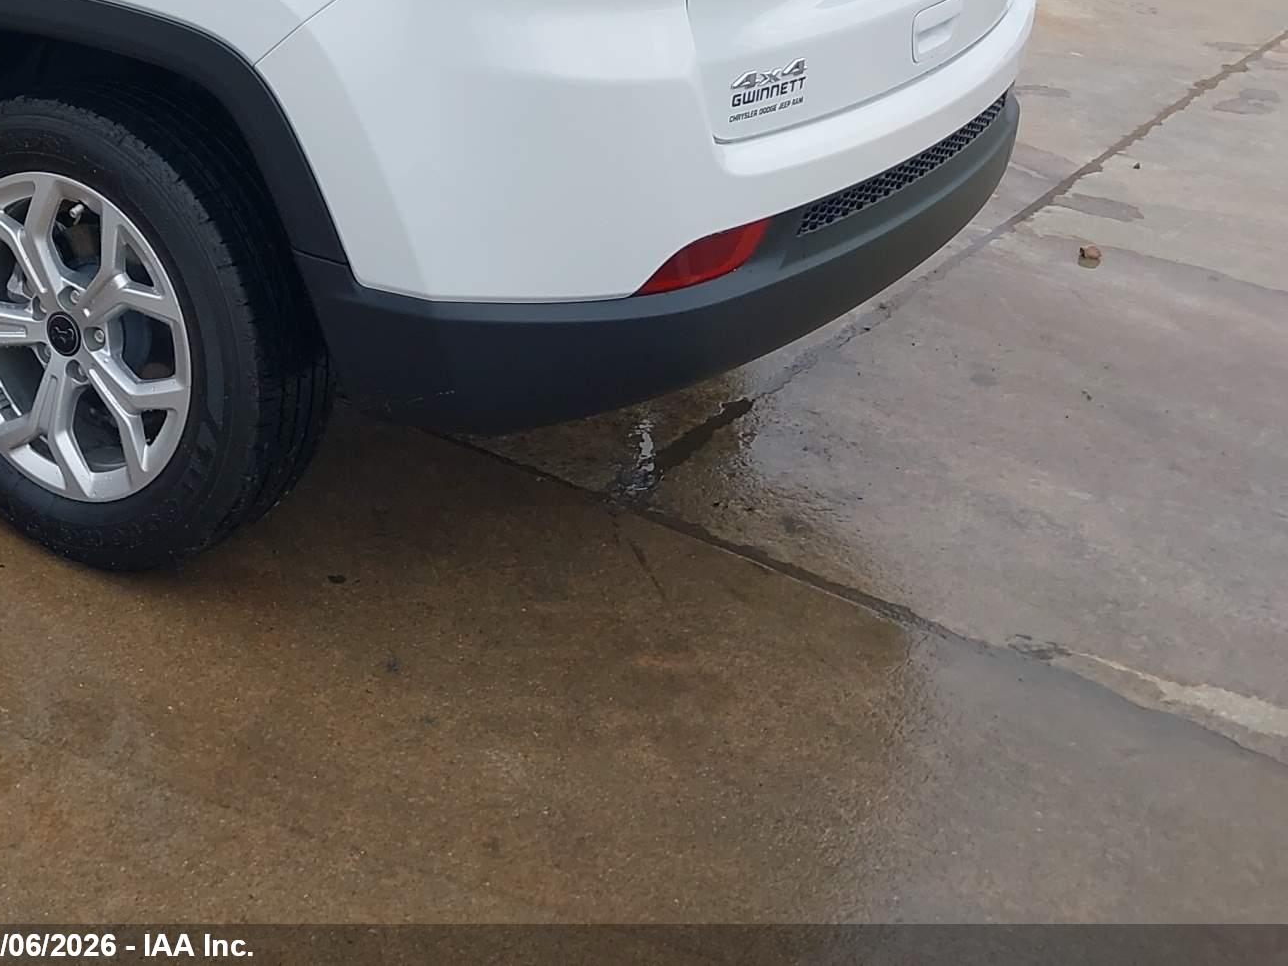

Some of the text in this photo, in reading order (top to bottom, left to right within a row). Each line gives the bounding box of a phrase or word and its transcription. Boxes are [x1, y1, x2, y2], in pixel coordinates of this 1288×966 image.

[732, 76, 806, 107] GWINNETT
[729, 110, 758, 122] CHRYSLER
[759, 103, 778, 115] DODGE
[778, 100, 791, 110] JEEP
